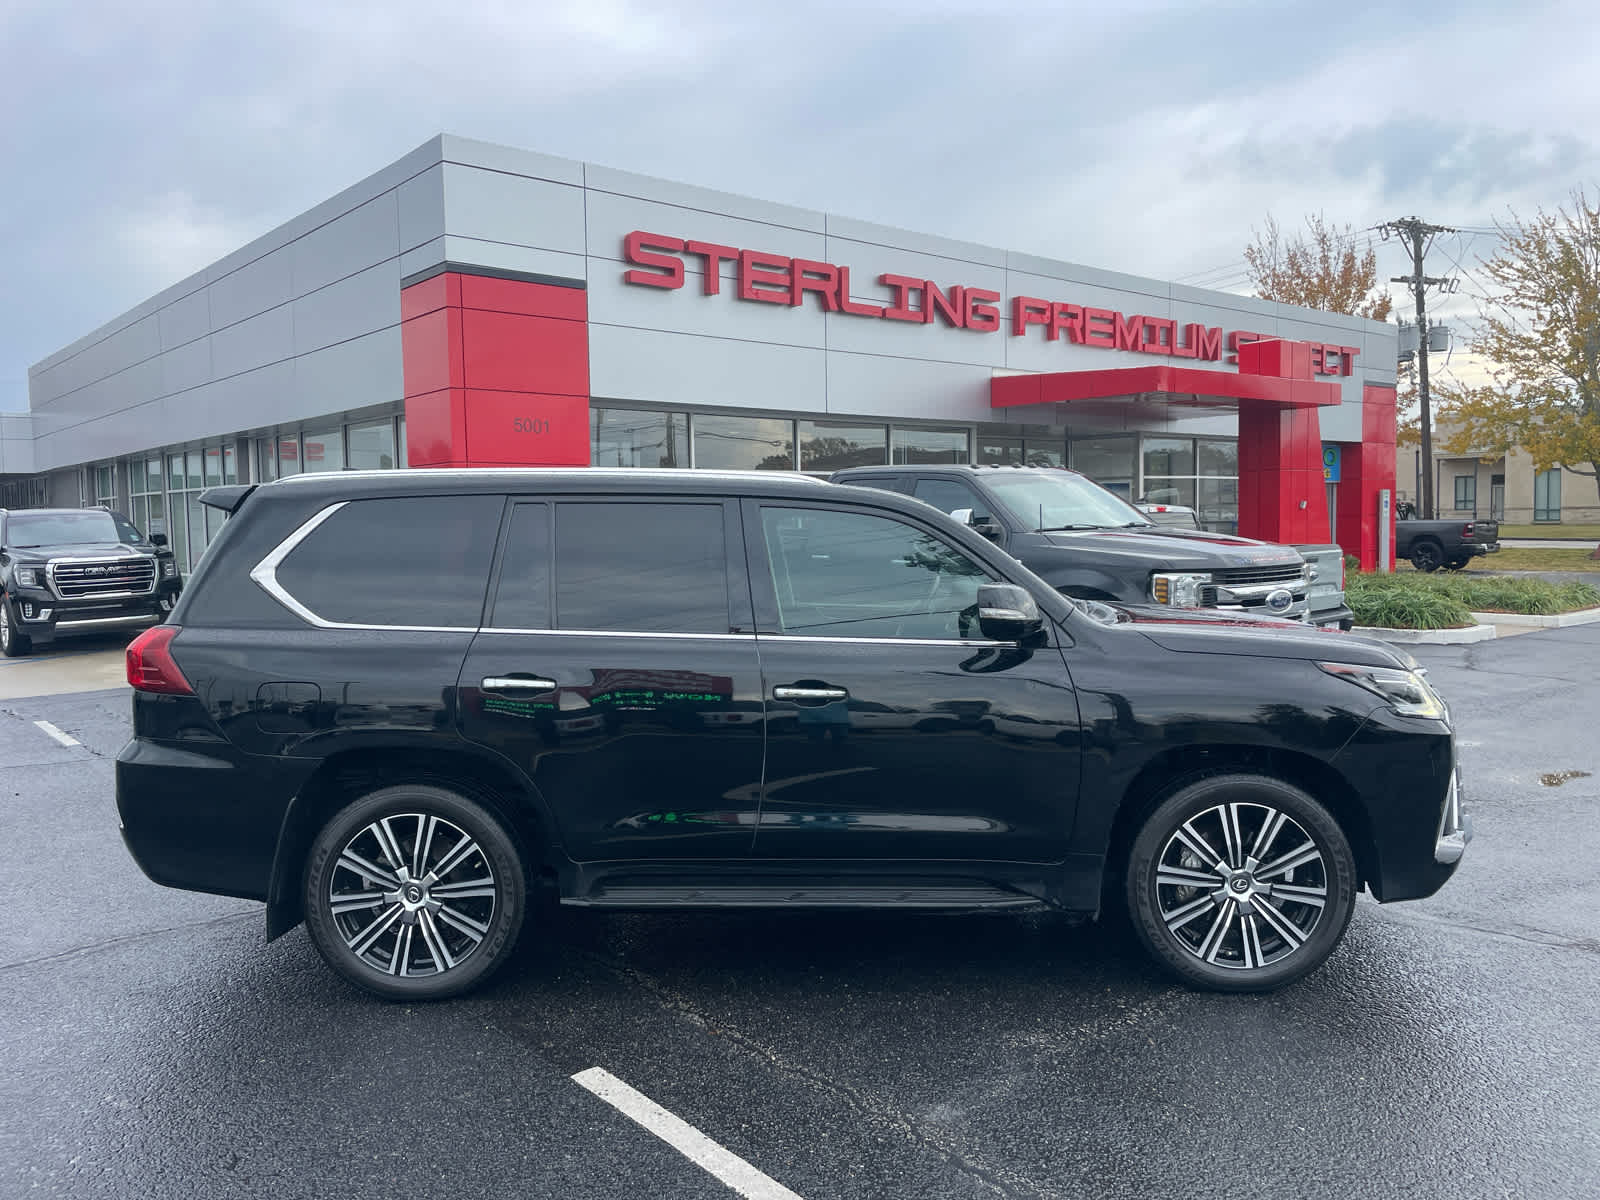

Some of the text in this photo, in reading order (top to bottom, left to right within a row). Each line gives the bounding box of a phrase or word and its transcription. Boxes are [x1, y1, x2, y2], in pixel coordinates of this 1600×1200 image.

[624, 230, 1360, 377] STERLING PREMIUM SECT
[513, 417, 549, 433] 5001
